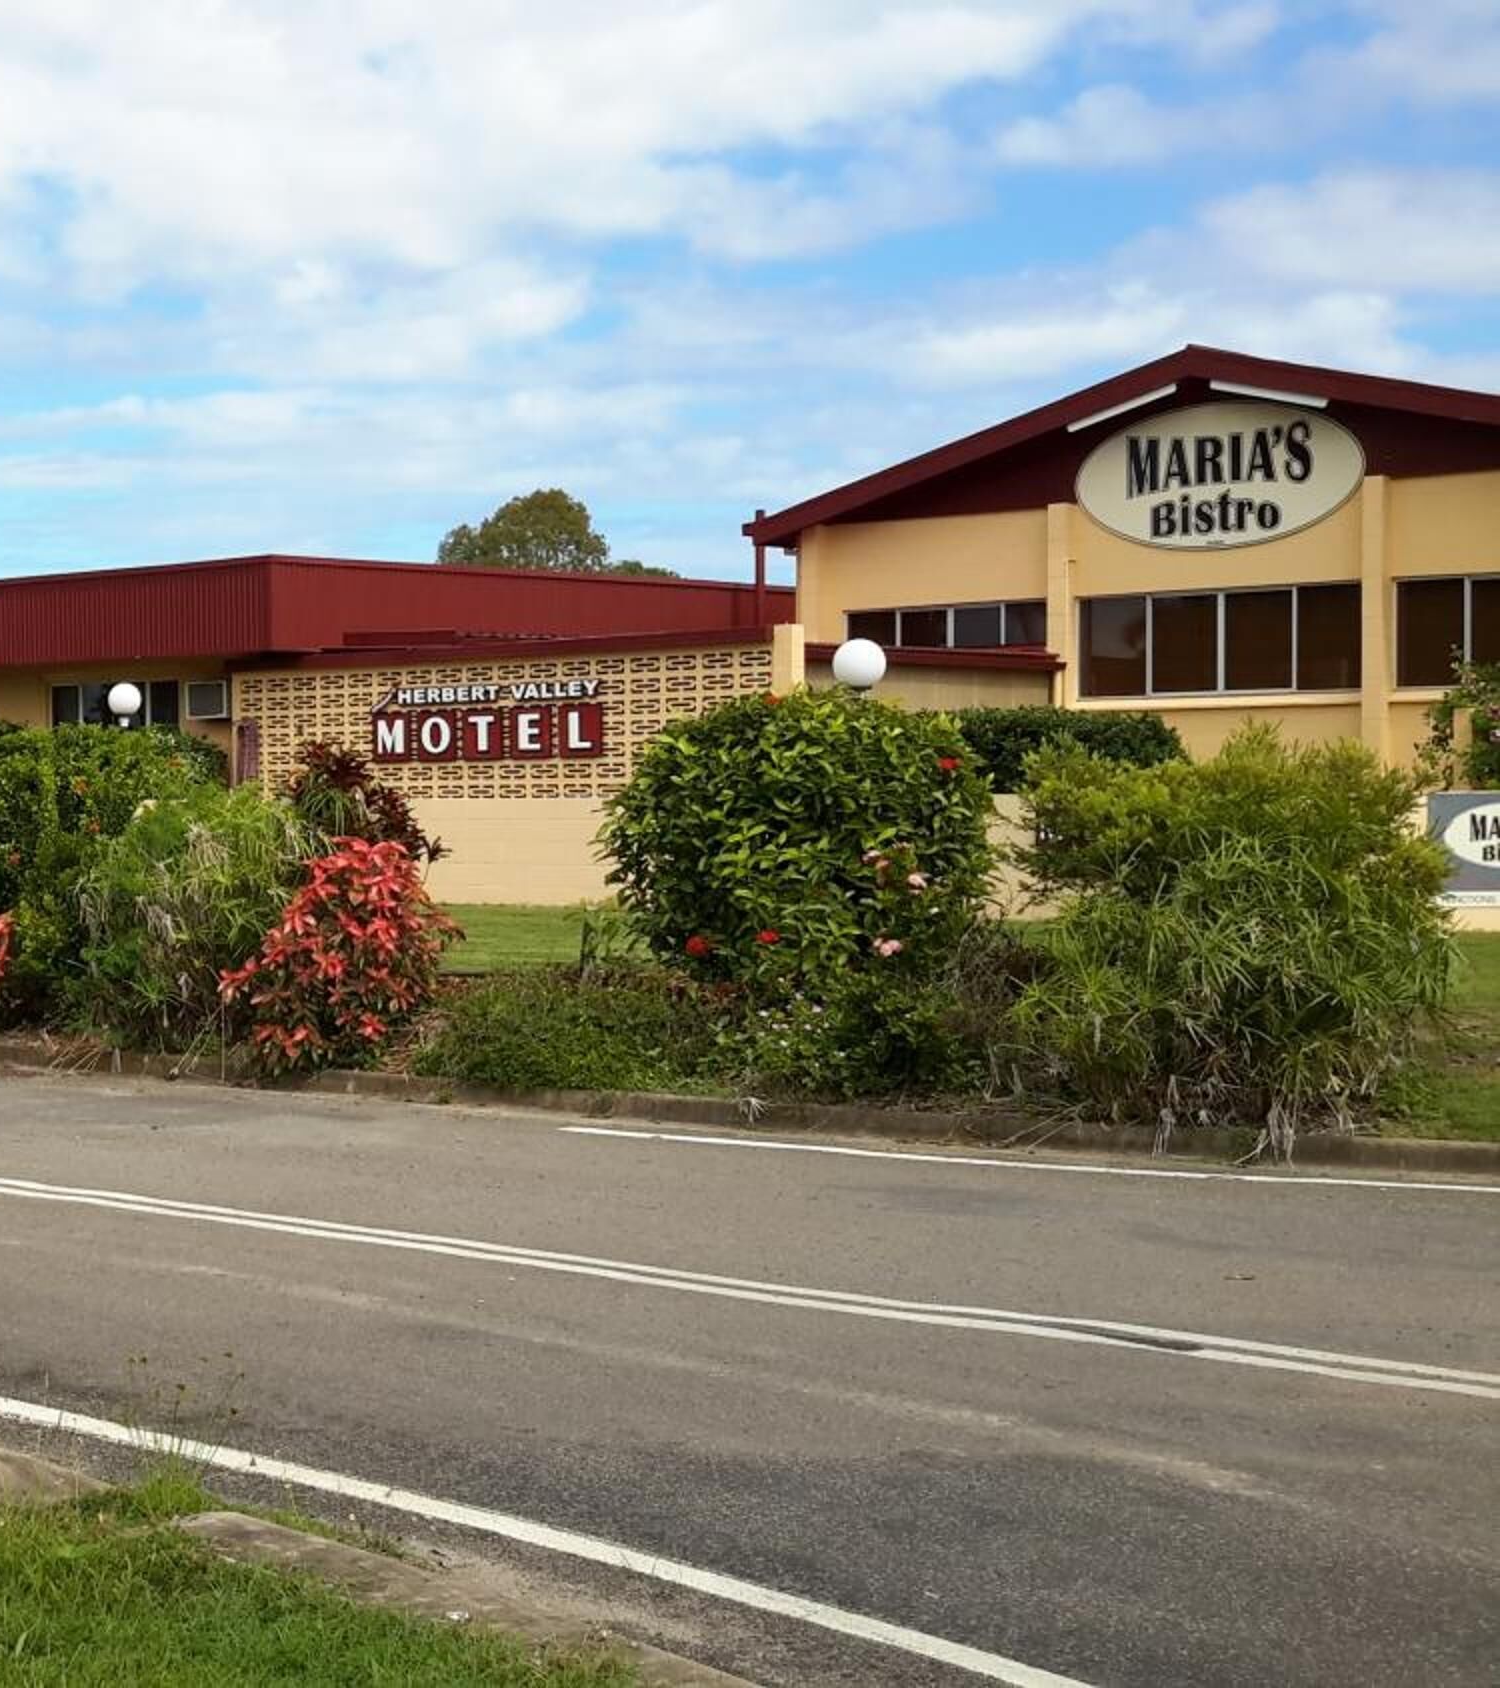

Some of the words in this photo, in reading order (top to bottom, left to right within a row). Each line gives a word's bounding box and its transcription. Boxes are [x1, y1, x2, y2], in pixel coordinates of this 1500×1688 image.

[1125, 418, 1314, 499] MARIA'S
[1151, 489, 1282, 538] Bistro
[397, 685, 500, 705] HERBERT
[510, 679, 599, 700] VALLEY
[376, 711, 593, 755] MOTEL
